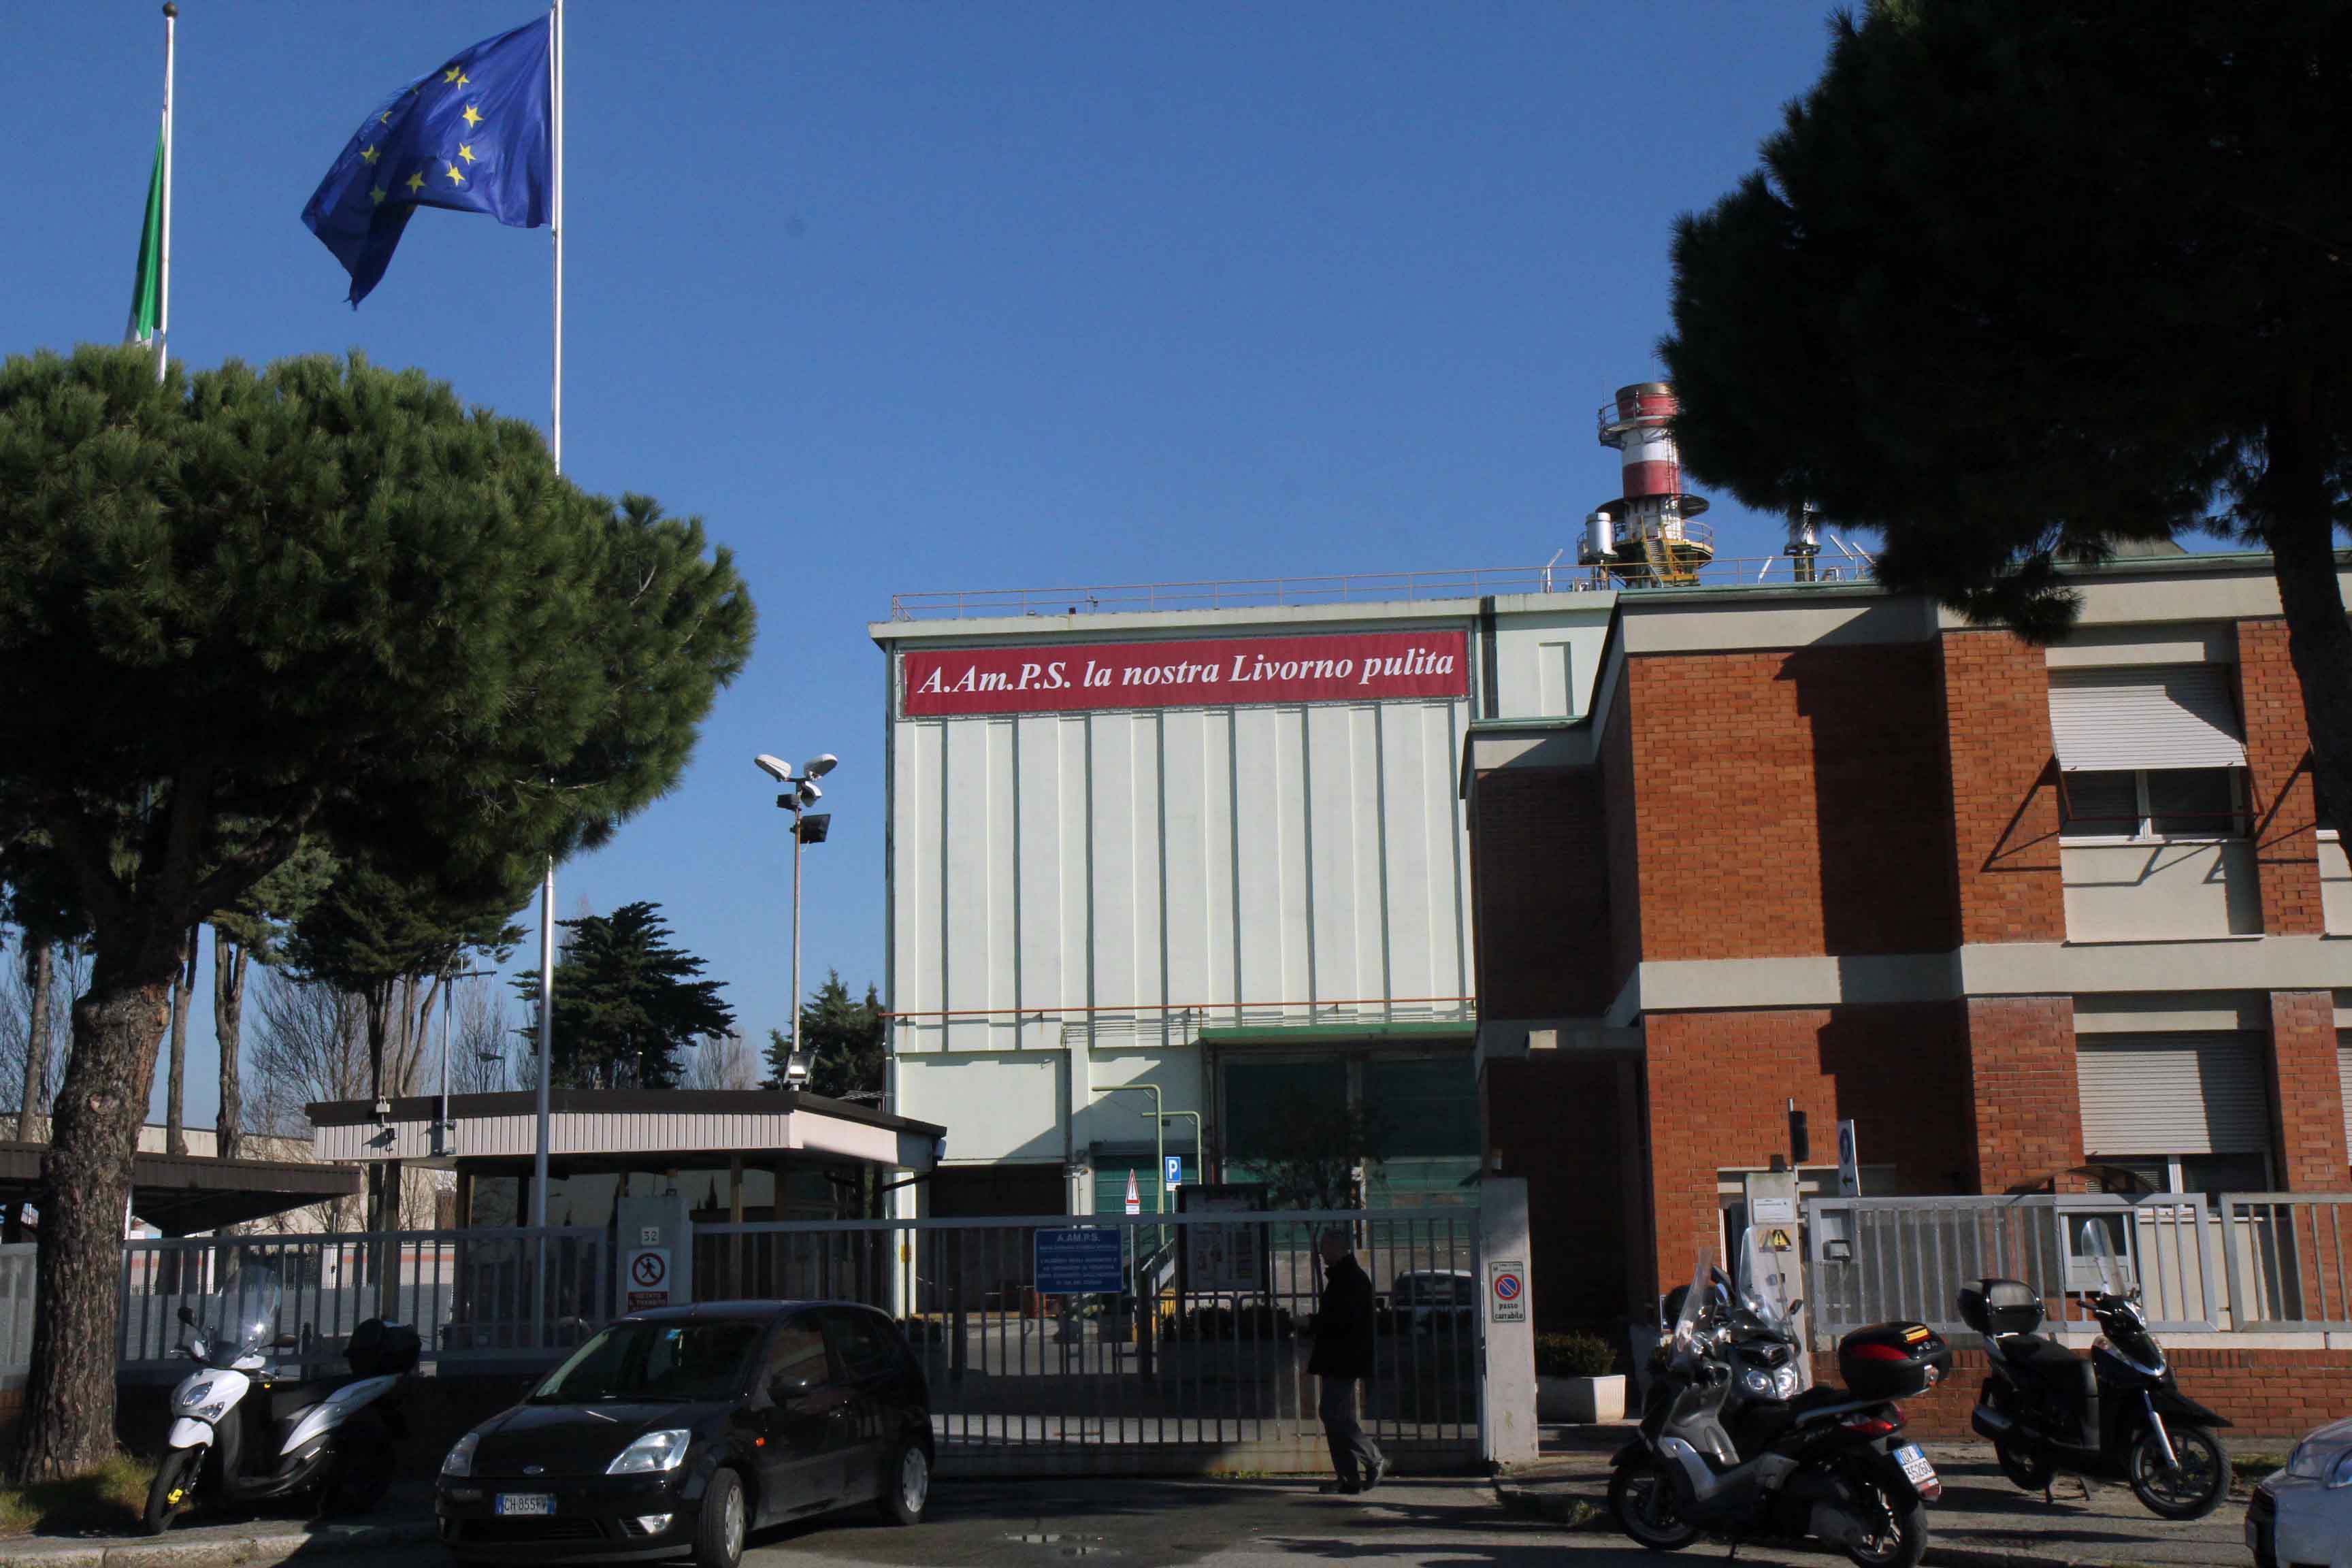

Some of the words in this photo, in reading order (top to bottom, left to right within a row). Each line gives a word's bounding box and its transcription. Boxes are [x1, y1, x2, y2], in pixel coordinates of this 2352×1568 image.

[917, 660, 1071, 694] A.Am.P.S.
[1083, 660, 1111, 687] la
[1122, 660, 1220, 686] nostra
[1228, 653, 1354, 683] Livorno
[1359, 648, 1454, 685] pulita
[1169, 1159, 1178, 1179] P
